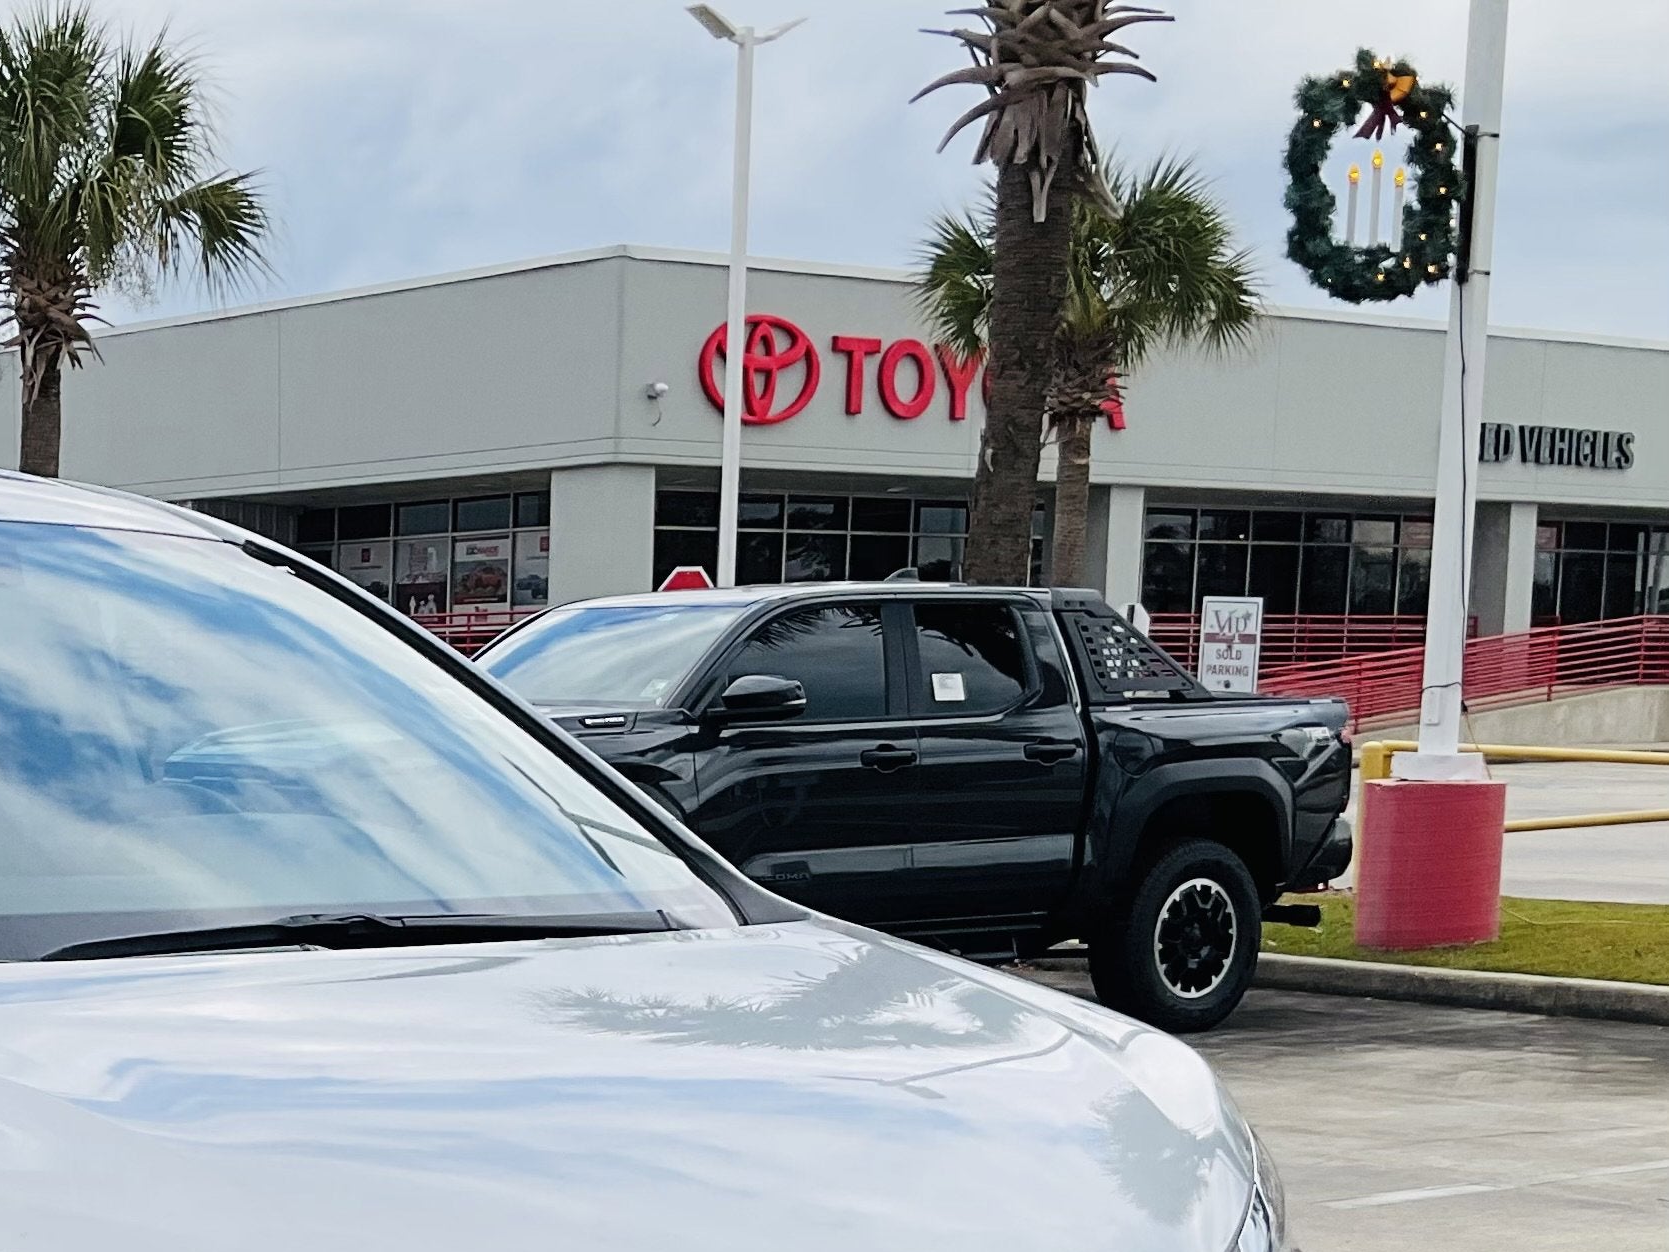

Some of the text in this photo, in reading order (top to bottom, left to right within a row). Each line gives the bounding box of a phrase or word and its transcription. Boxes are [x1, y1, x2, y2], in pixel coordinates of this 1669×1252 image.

[832, 335, 1127, 430] TOY
[1518, 424, 1636, 470] VEHICLES
[1215, 648, 1242, 661] SOLD
[1206, 664, 1250, 677] PARKING
